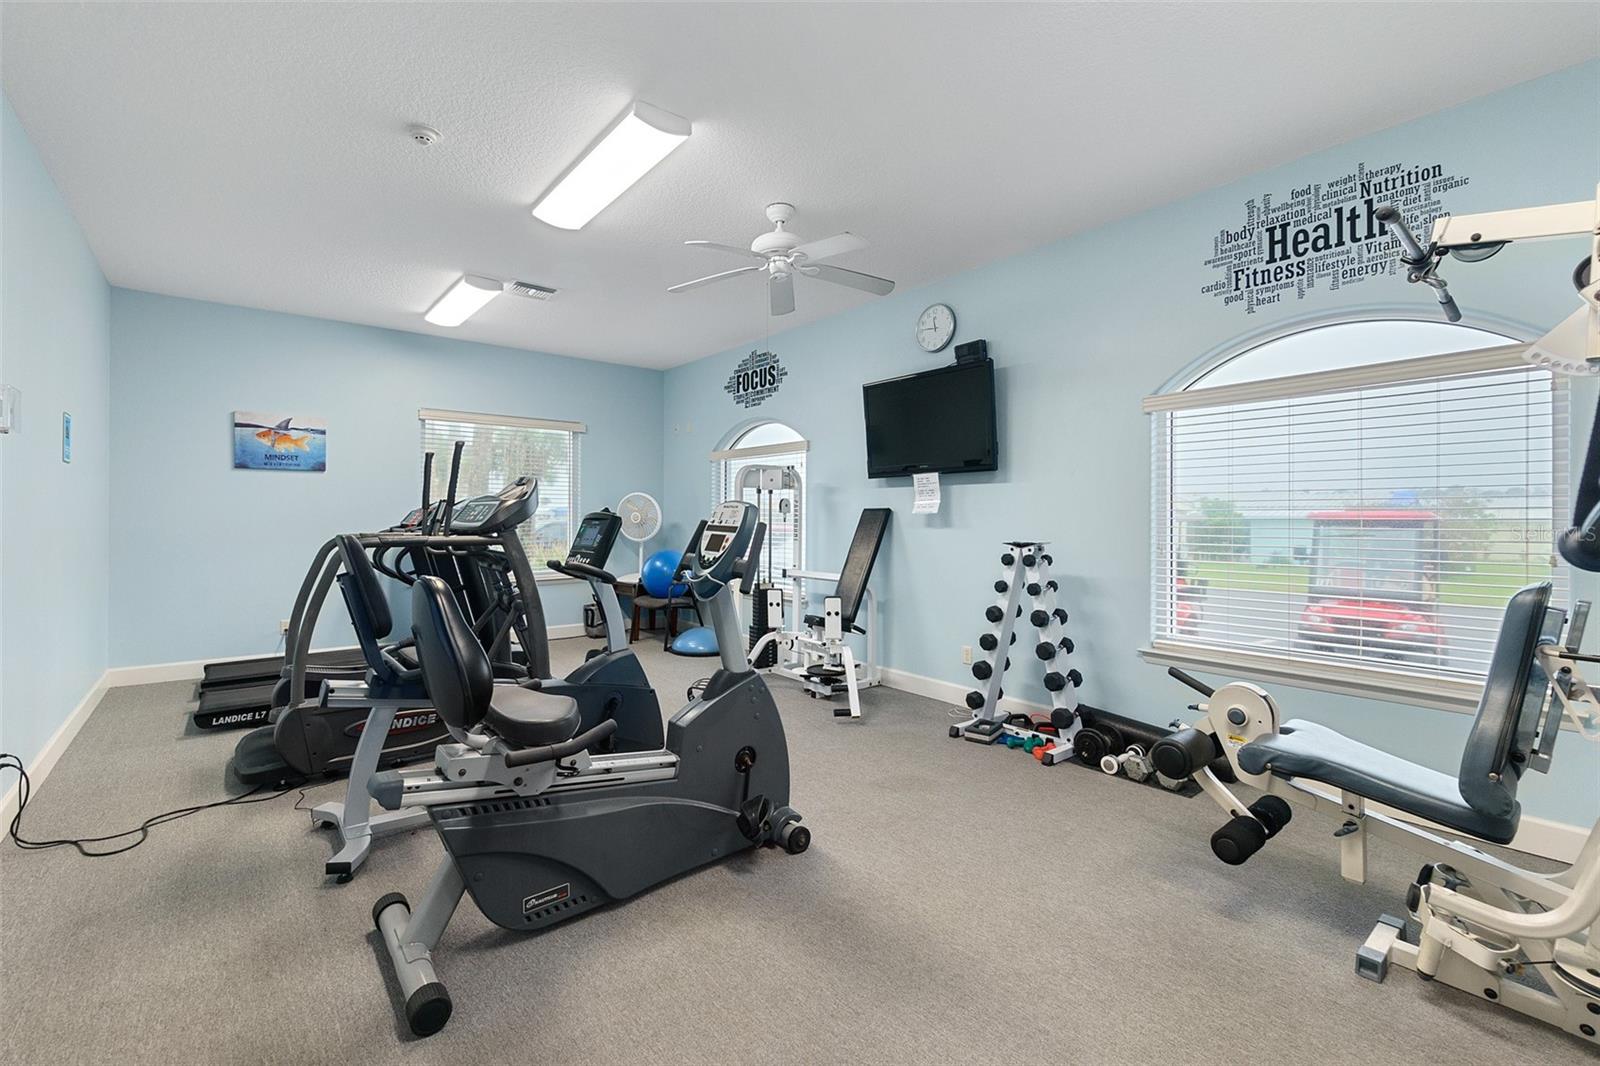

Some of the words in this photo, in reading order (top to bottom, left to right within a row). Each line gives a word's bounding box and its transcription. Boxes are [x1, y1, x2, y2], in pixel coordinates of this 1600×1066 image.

[1365, 163, 1402, 180] therapy
[1328, 174, 1356, 188] weight
[1360, 164, 1442, 199] Nutrition
[1433, 176, 1454, 186] issues
[1433, 177, 1470, 194] organic
[1291, 184, 1312, 200] food
[1322, 182, 1357, 201] clinical
[1377, 184, 1420, 203] anatomy
[1271, 198, 1306, 214] wellbeing
[1403, 194, 1422, 206] diet
[1256, 208, 1306, 229] relaxation
[1293, 208, 1332, 228] medical
[1226, 226, 1256, 244] body
[1265, 199, 1388, 265] Health
[1220, 240, 1256, 255] healthcare
[1234, 247, 1256, 261] sport
[1233, 256, 1264, 269] nutrients
[1315, 256, 1356, 273] lifestyle
[1366, 250, 1400, 263] aerobics
[1233, 260, 1306, 292] Fitness
[1342, 260, 1388, 280] energy
[1201, 280, 1226, 293] cardio
[1256, 280, 1294, 295] symptoms
[1224, 291, 1244, 305] good
[1256, 293, 1280, 306] heart
[736, 364, 776, 394] FOCUS
[212, 712, 254, 725] LANDICE
[255, 711, 267, 719] L7
[392, 714, 437, 729] NDICE
